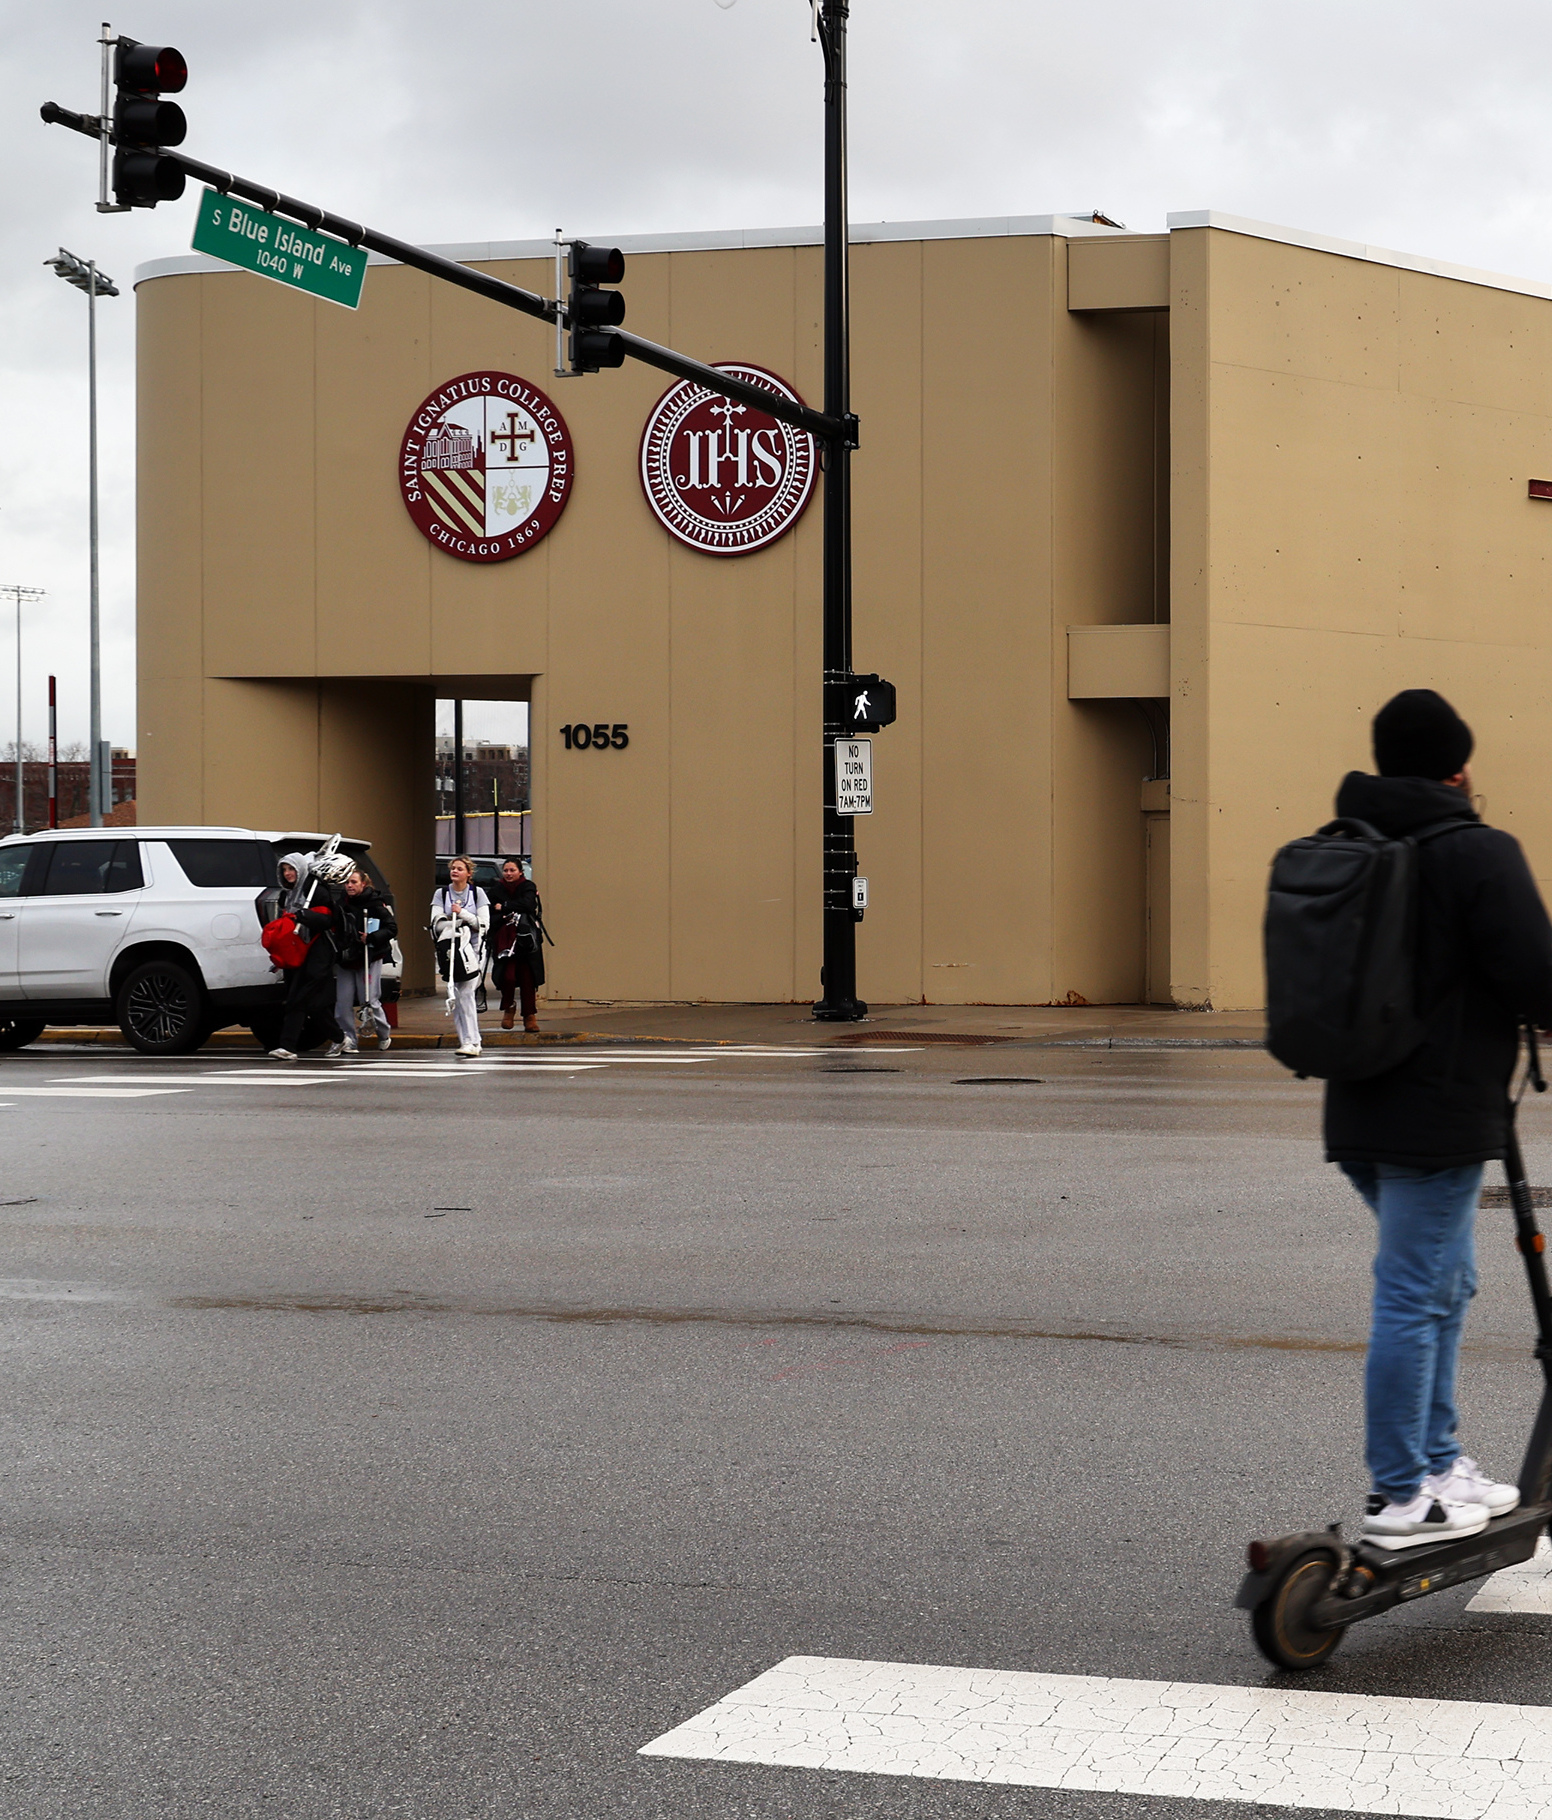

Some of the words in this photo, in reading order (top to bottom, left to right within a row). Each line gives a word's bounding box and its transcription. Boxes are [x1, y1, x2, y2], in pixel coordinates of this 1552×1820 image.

[212, 208, 222, 226] S
[228, 207, 269, 243] Blue
[274, 226, 326, 265] Island
[329, 255, 352, 276] Ave
[256, 249, 287, 273] 1040
[292, 262, 304, 279] W
[412, 377, 491, 436] IGNATIUS
[496, 379, 563, 444] COLLEGE
[499, 422, 507, 431] A
[518, 421, 528, 430] M
[499, 442, 507, 451] D
[519, 441, 527, 451] G
[404, 439, 422, 502] SAINT
[548, 449, 567, 503] PREP
[429, 523, 500, 555] CHICAGO
[507, 519, 541, 549] 1869
[560, 723, 629, 750] 1055
[848, 744, 859, 758] NO
[844, 762, 864, 775] TURN
[841, 778, 852, 791] ON
[853, 778, 868, 791] RED
[839, 795, 871, 809] 7AM-7PM
